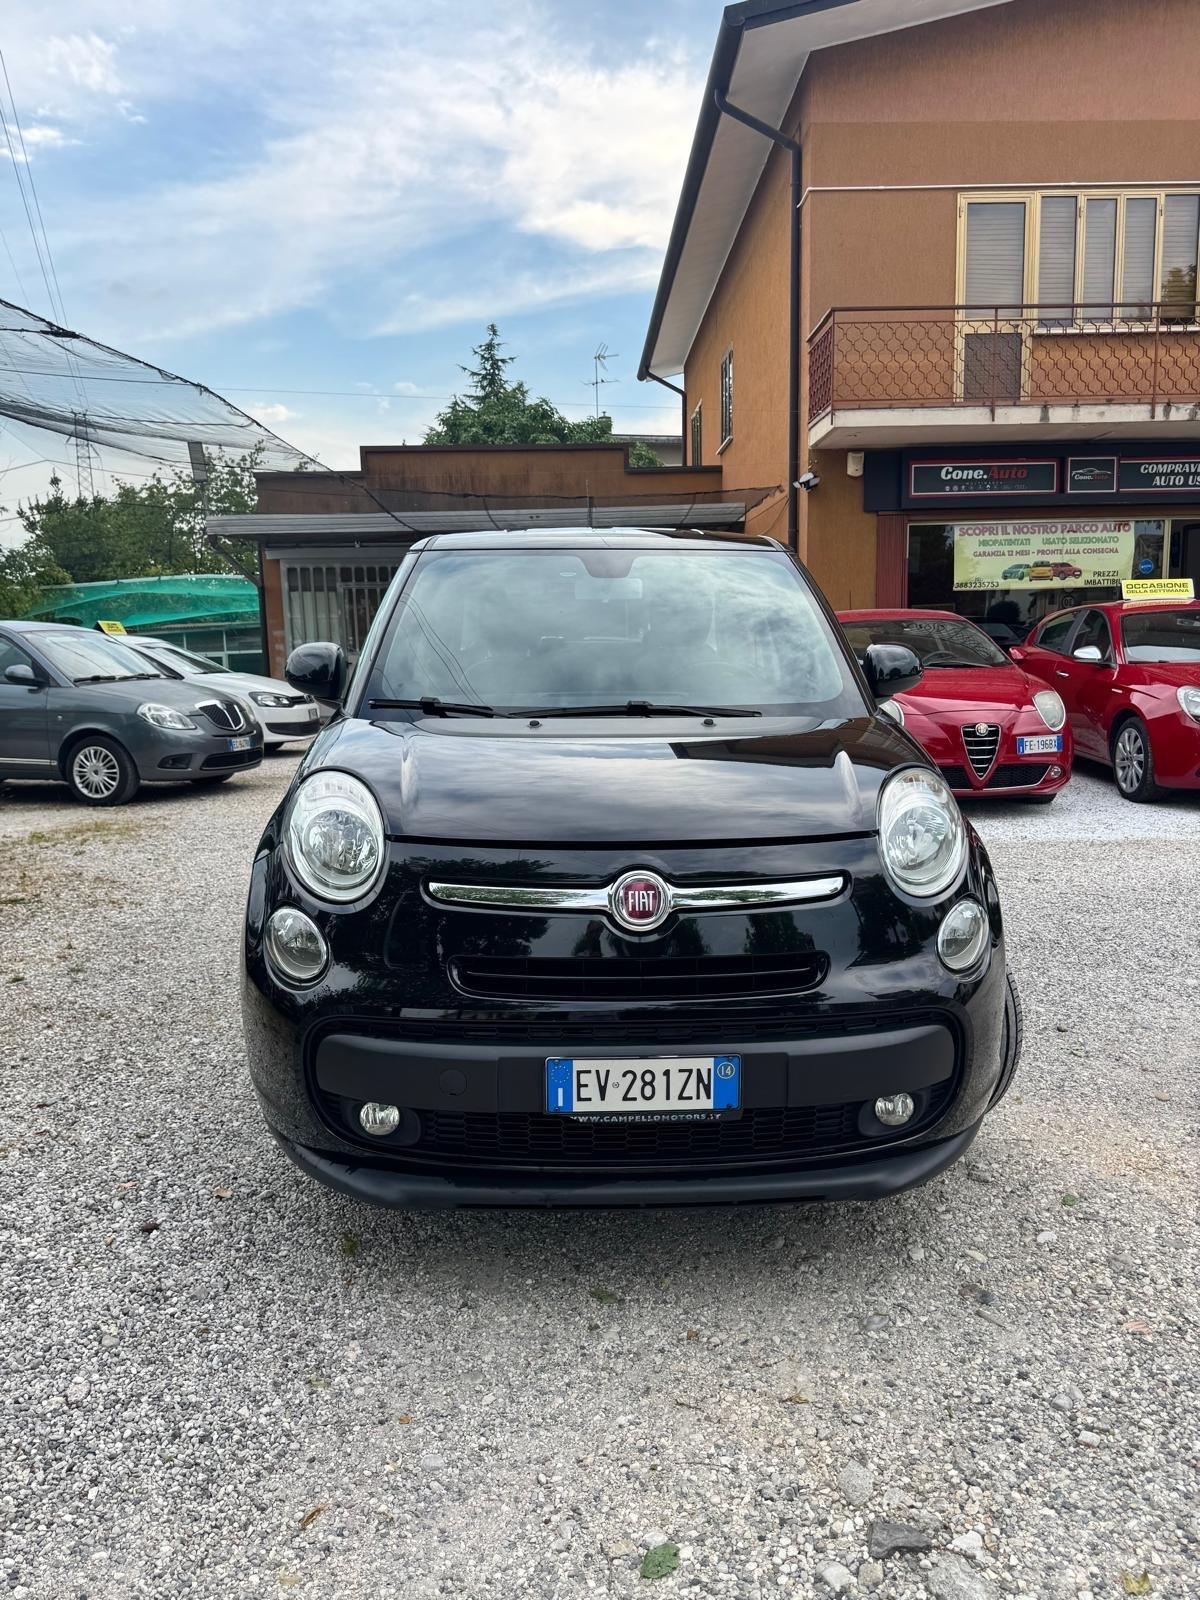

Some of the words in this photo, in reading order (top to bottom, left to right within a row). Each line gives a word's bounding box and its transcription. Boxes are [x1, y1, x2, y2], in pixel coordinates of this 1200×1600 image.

[940, 466, 1028, 480] Cone.Auto
[1152, 475, 1184, 486] AUTO
[958, 525, 999, 537] SCOPRI
[1001, 525, 1010, 535] IL
[1012, 524, 1058, 536] NOSTRO
[1060, 523, 1099, 534] PARCO
[1101, 522, 1131, 533] AUTO
[1042, 536, 1068, 545] USATO
[1036, 548, 1063, 556] PRONTE
[1064, 547, 1081, 555] ALLA
[1082, 547, 1119, 555] CONSEGNA
[1125, 582, 1189, 590] OCCASIONE
[628, 890, 655, 912] FIAT
[721, 1066, 732, 1076] 14
[576, 1069, 611, 1102] EV
[621, 1067, 712, 1102] 281ZN
